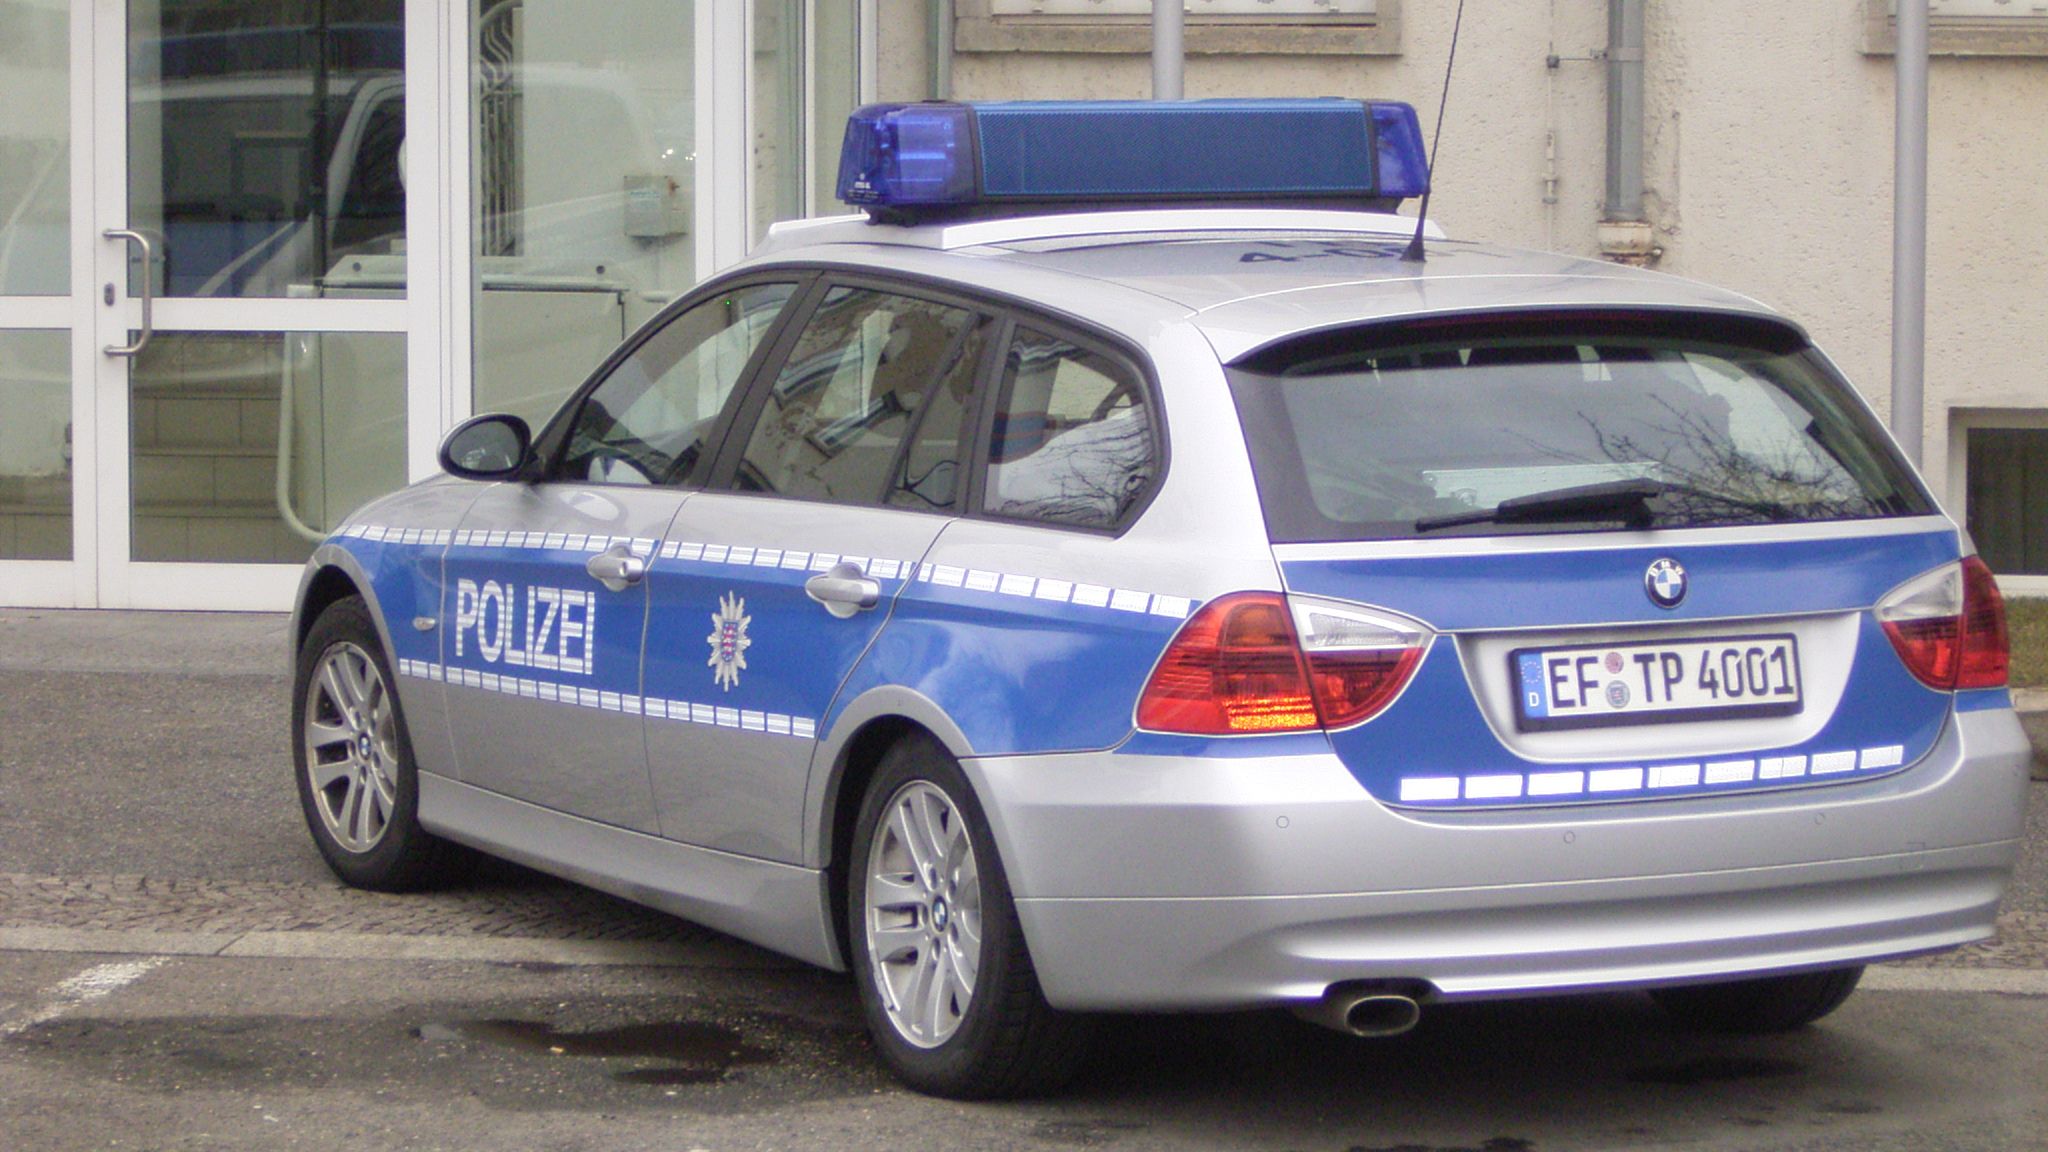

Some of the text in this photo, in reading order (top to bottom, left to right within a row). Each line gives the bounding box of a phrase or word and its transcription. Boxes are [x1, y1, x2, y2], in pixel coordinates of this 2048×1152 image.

[456, 579, 595, 675] POLIZEI
[1528, 691, 1540, 707] D
[1548, 646, 1794, 708] EF TP 4001
